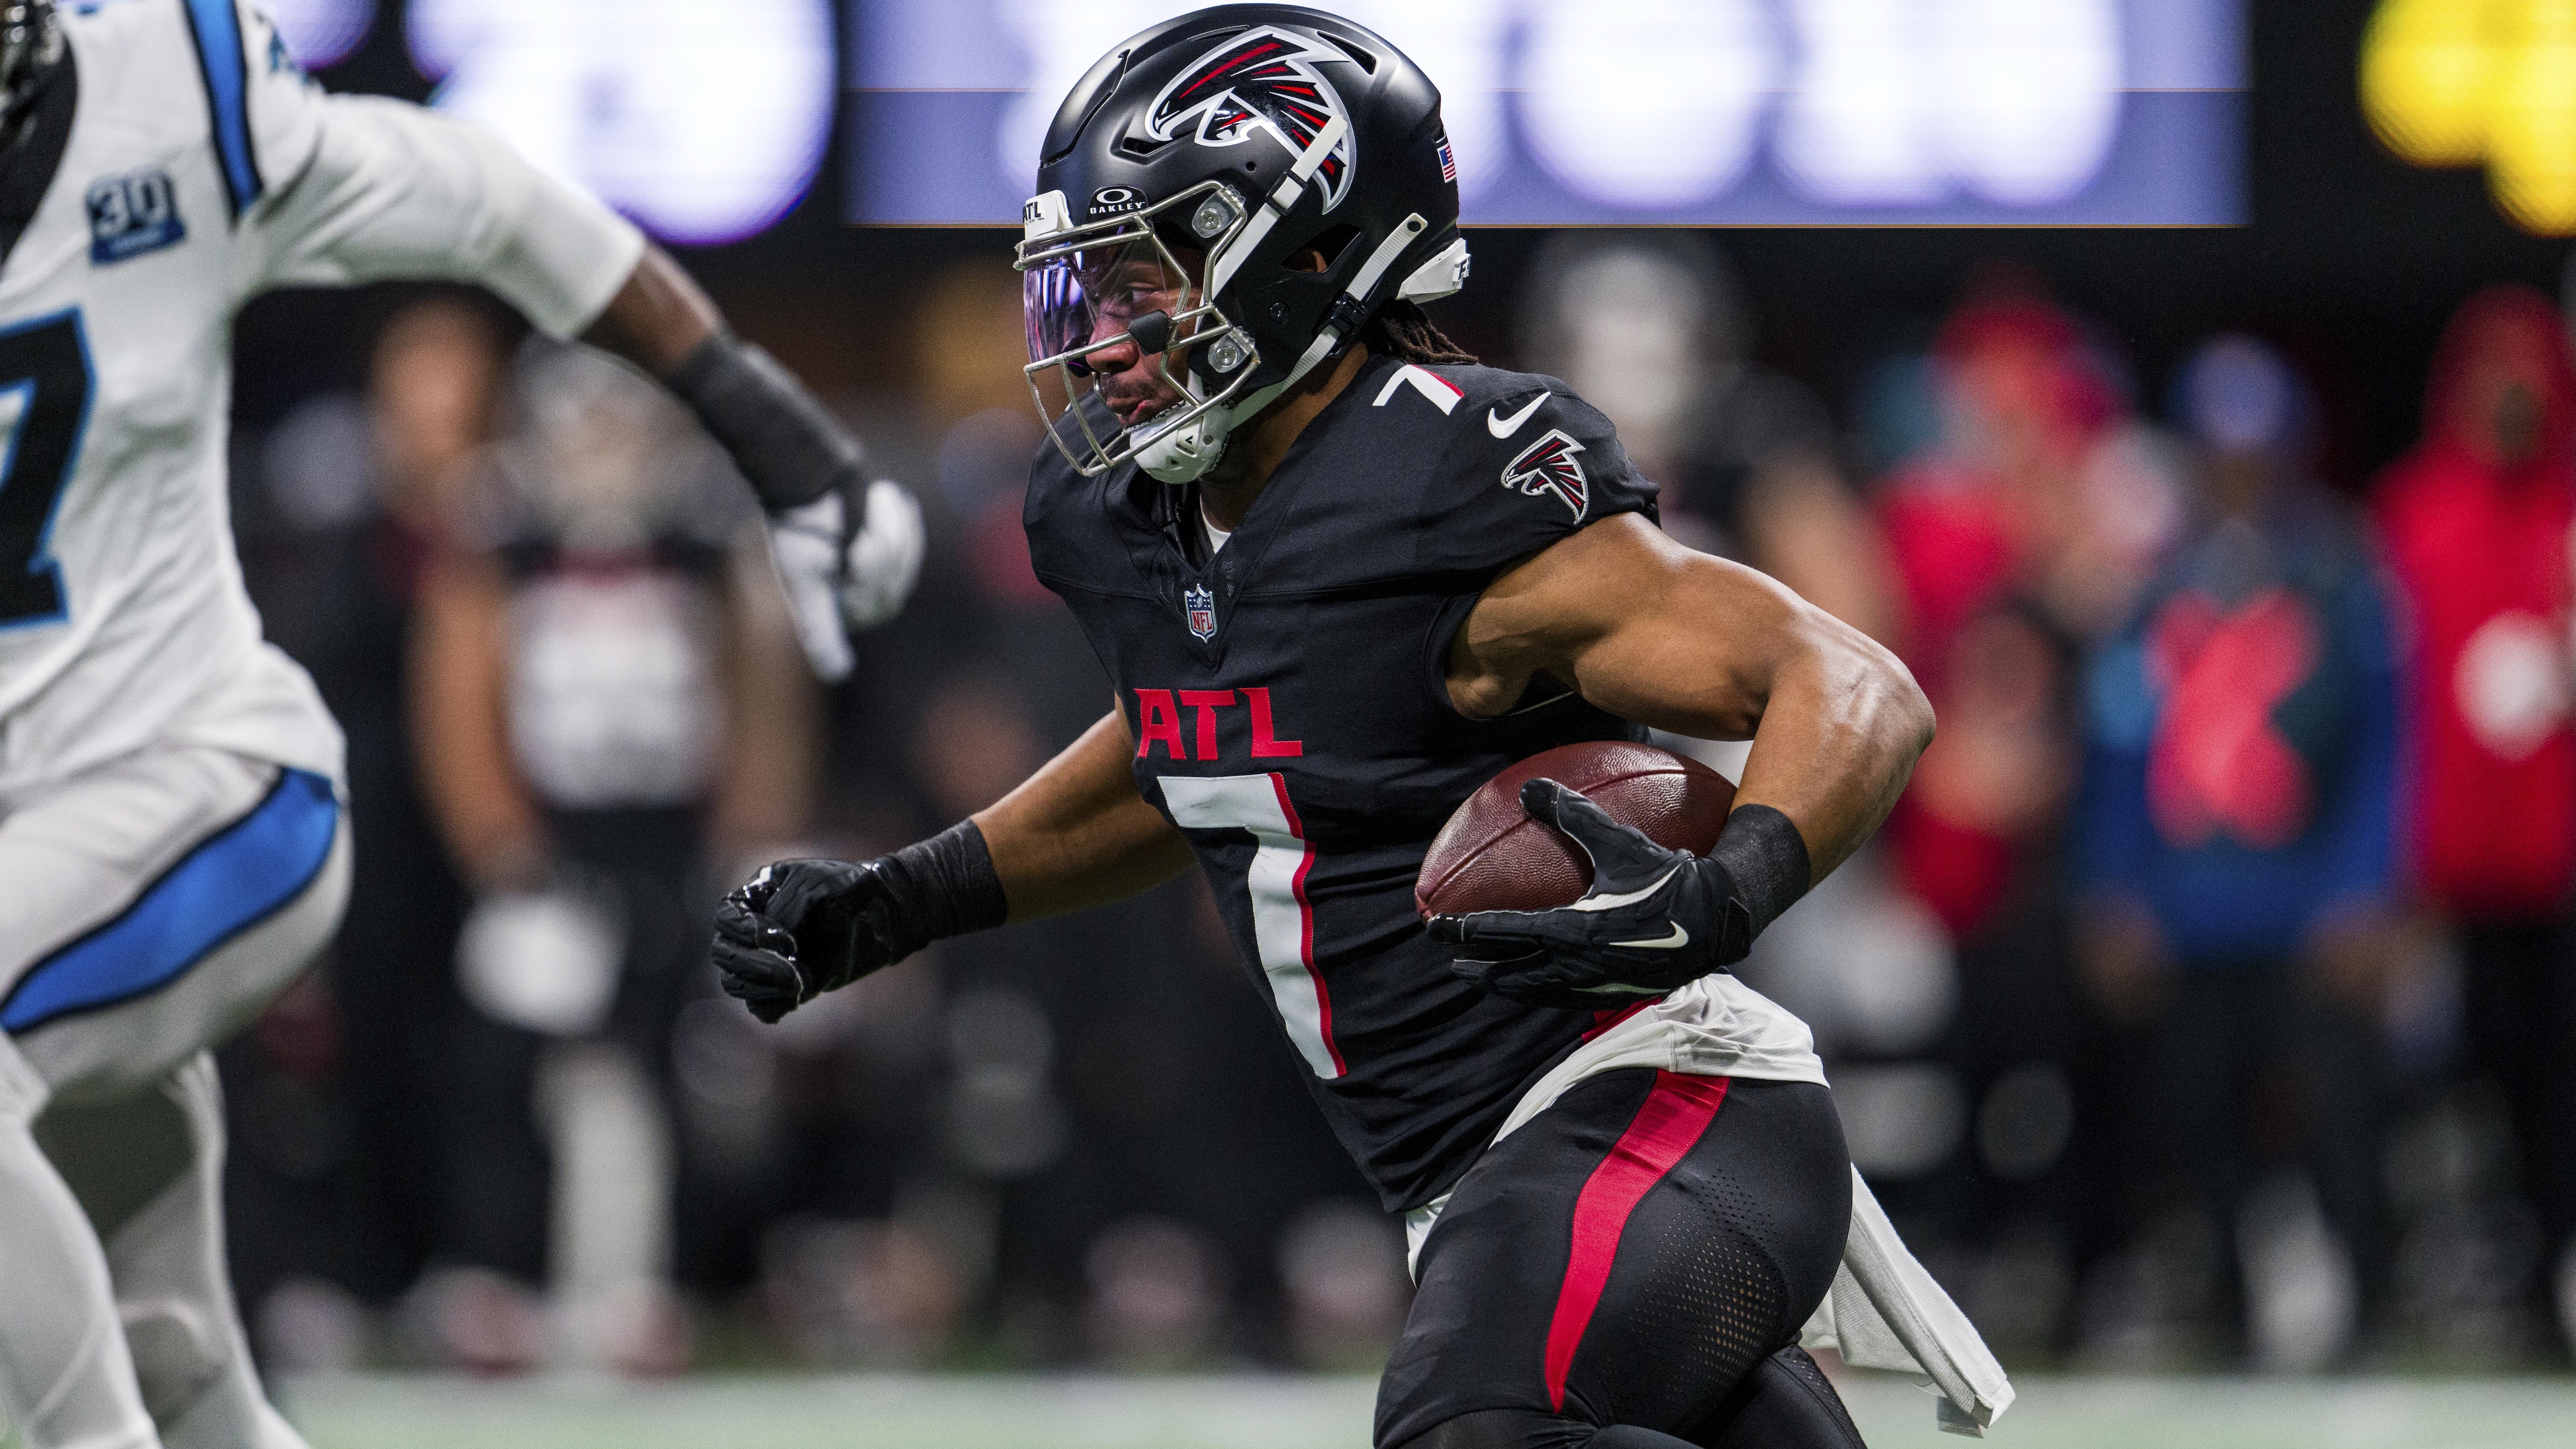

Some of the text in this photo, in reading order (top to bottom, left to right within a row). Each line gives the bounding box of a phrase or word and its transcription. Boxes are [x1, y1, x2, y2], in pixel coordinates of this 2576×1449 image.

[89, 173, 171, 235] 30
[1023, 201, 1041, 223] ATL
[1090, 202, 1142, 214] OAKLEY
[1372, 364, 1465, 416] 7
[1191, 612, 1212, 633] NFL
[1133, 687, 1302, 761] ATL
[1157, 773, 1347, 1080] 7
